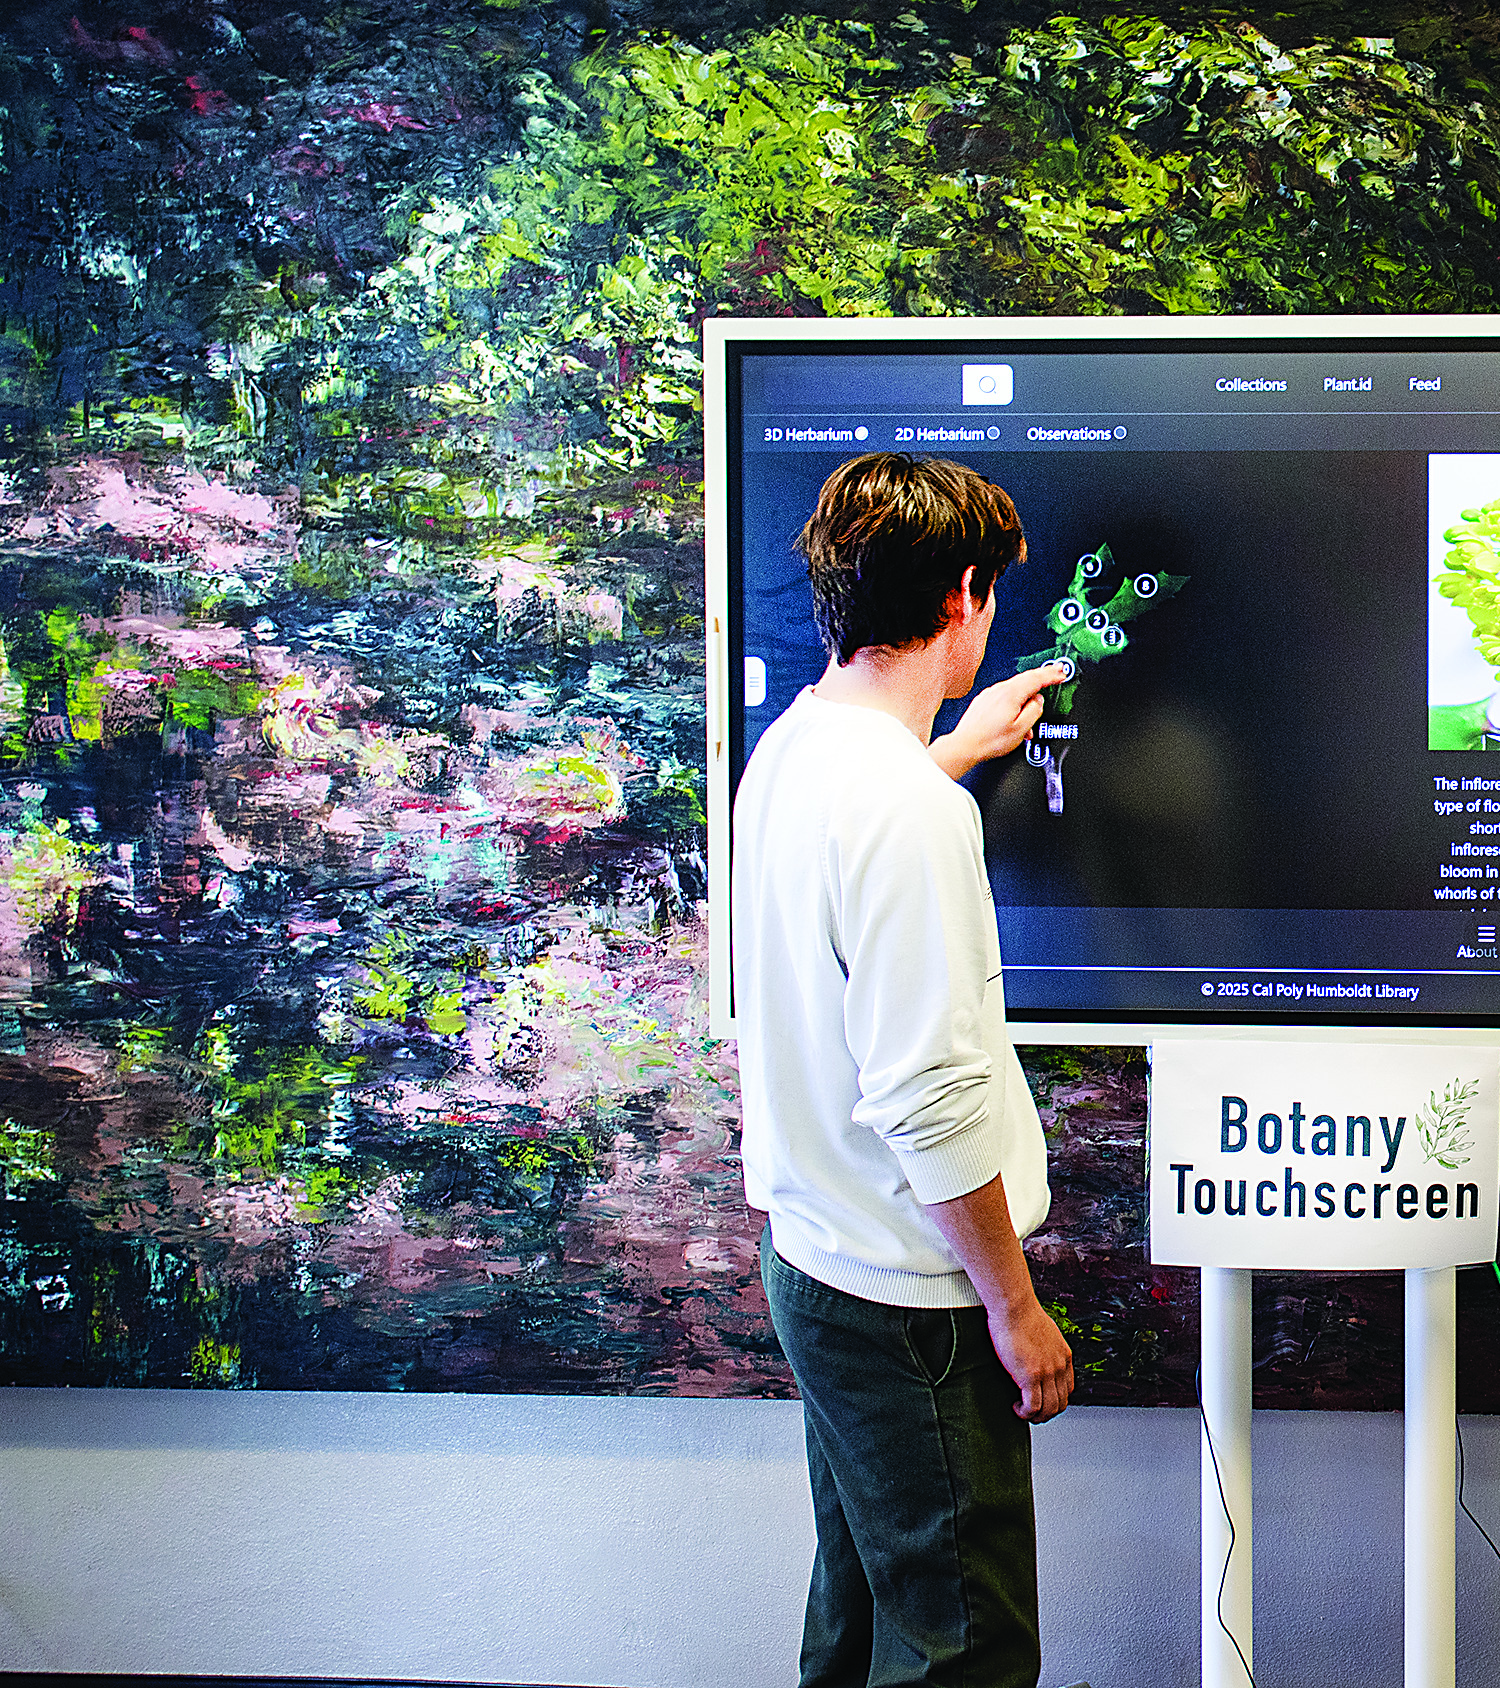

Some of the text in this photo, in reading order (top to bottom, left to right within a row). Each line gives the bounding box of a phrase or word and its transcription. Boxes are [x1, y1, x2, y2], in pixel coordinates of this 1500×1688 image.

[1215, 377, 1288, 392] Collections
[1323, 377, 1372, 392] Plant.id
[1409, 376, 1441, 391] Feed
[764, 426, 853, 442] 3D Herbarium
[894, 426, 985, 442] 2D Herbarium
[1026, 426, 1111, 441] Observations
[1433, 776, 1459, 791] The
[1433, 799, 1464, 816] type
[1465, 798, 1482, 813] of
[1440, 864, 1483, 879] bloom
[1485, 864, 1499, 879] in
[1433, 886, 1478, 900] whorls
[1479, 886, 1496, 900] of
[1456, 944, 1498, 959] About
[1217, 982, 1250, 996] 2025
[1252, 982, 1273, 997] Cal
[1276, 983, 1304, 1000] Poly
[1306, 983, 1373, 998] Humboldt
[1375, 984, 1420, 1002] Library
[1220, 1095, 1407, 1174] Botany
[1169, 1163, 1479, 1219] Touchscreen
